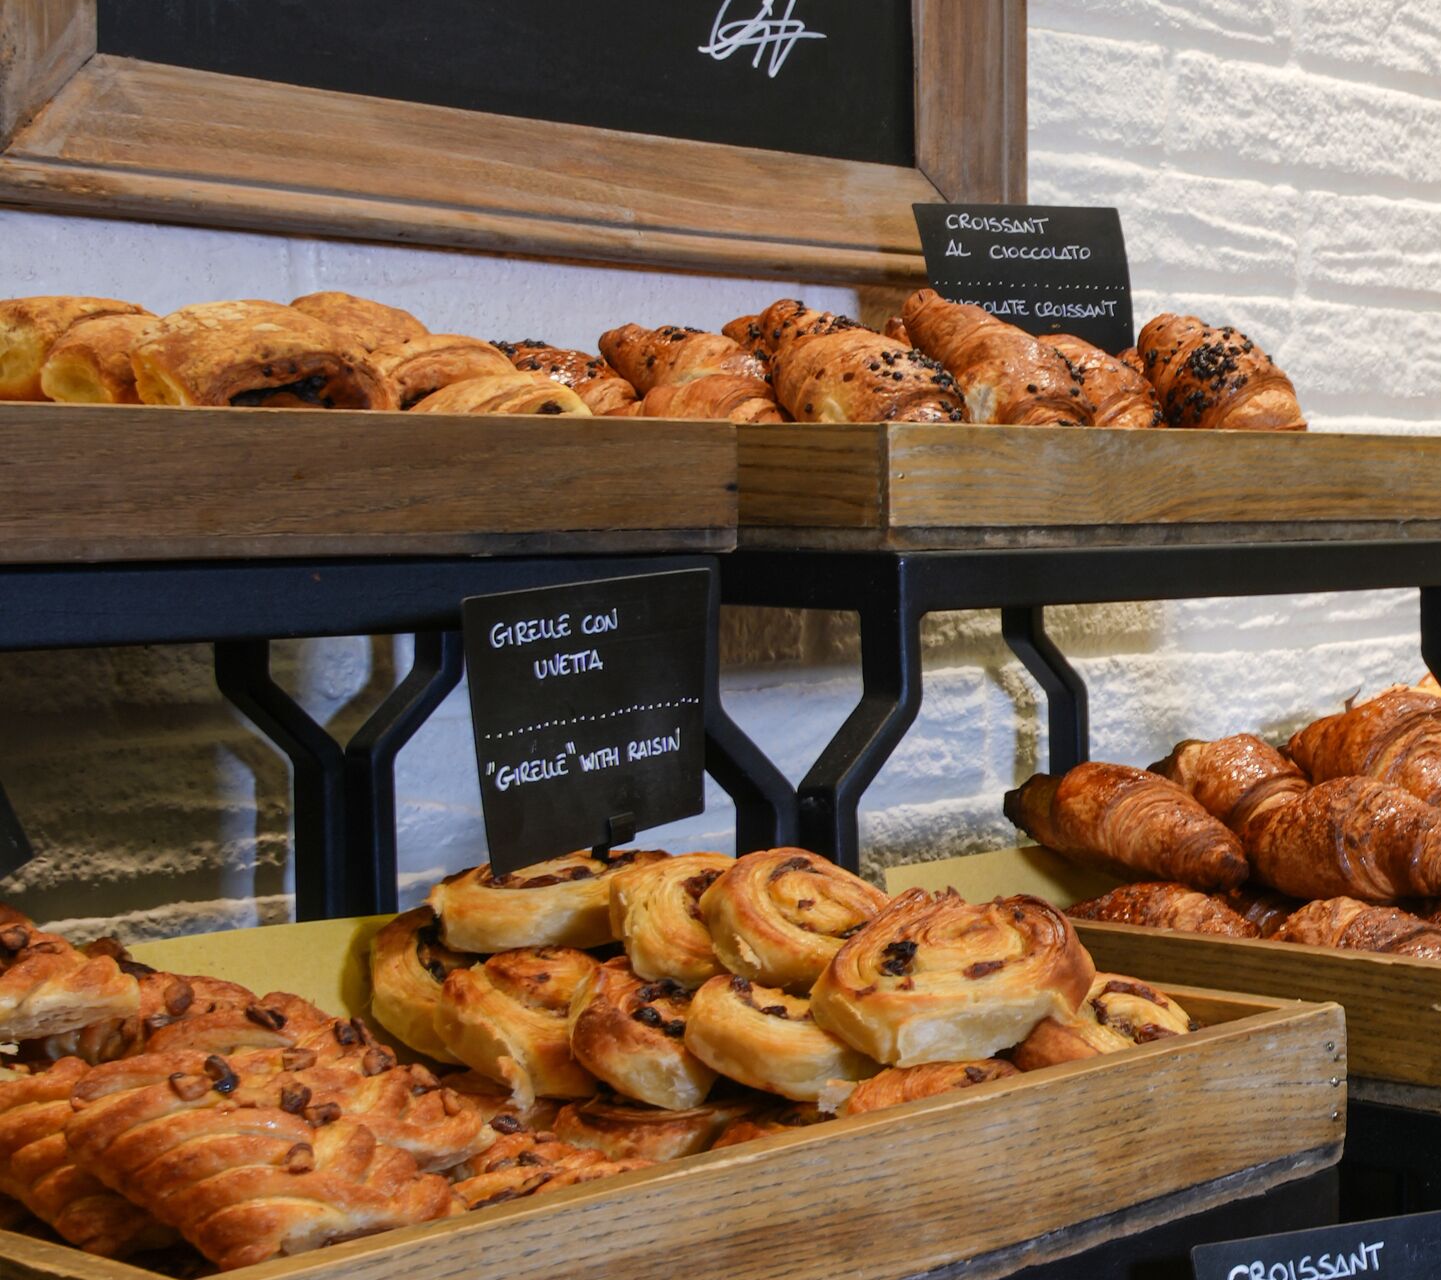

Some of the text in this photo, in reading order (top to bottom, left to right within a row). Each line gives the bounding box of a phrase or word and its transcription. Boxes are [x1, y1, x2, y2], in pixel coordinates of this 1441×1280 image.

[945, 213, 1049, 234] CROISSANT
[945, 239, 1091, 260] AL CIOCCOLATO
[945, 298, 1117, 318] OLATE CROISSANT
[489, 607, 618, 649] GIRELLE CON
[533, 649, 603, 680] UVETTA
[578, 746, 621, 773] WITH
[627, 727, 681, 763] RAISIN
